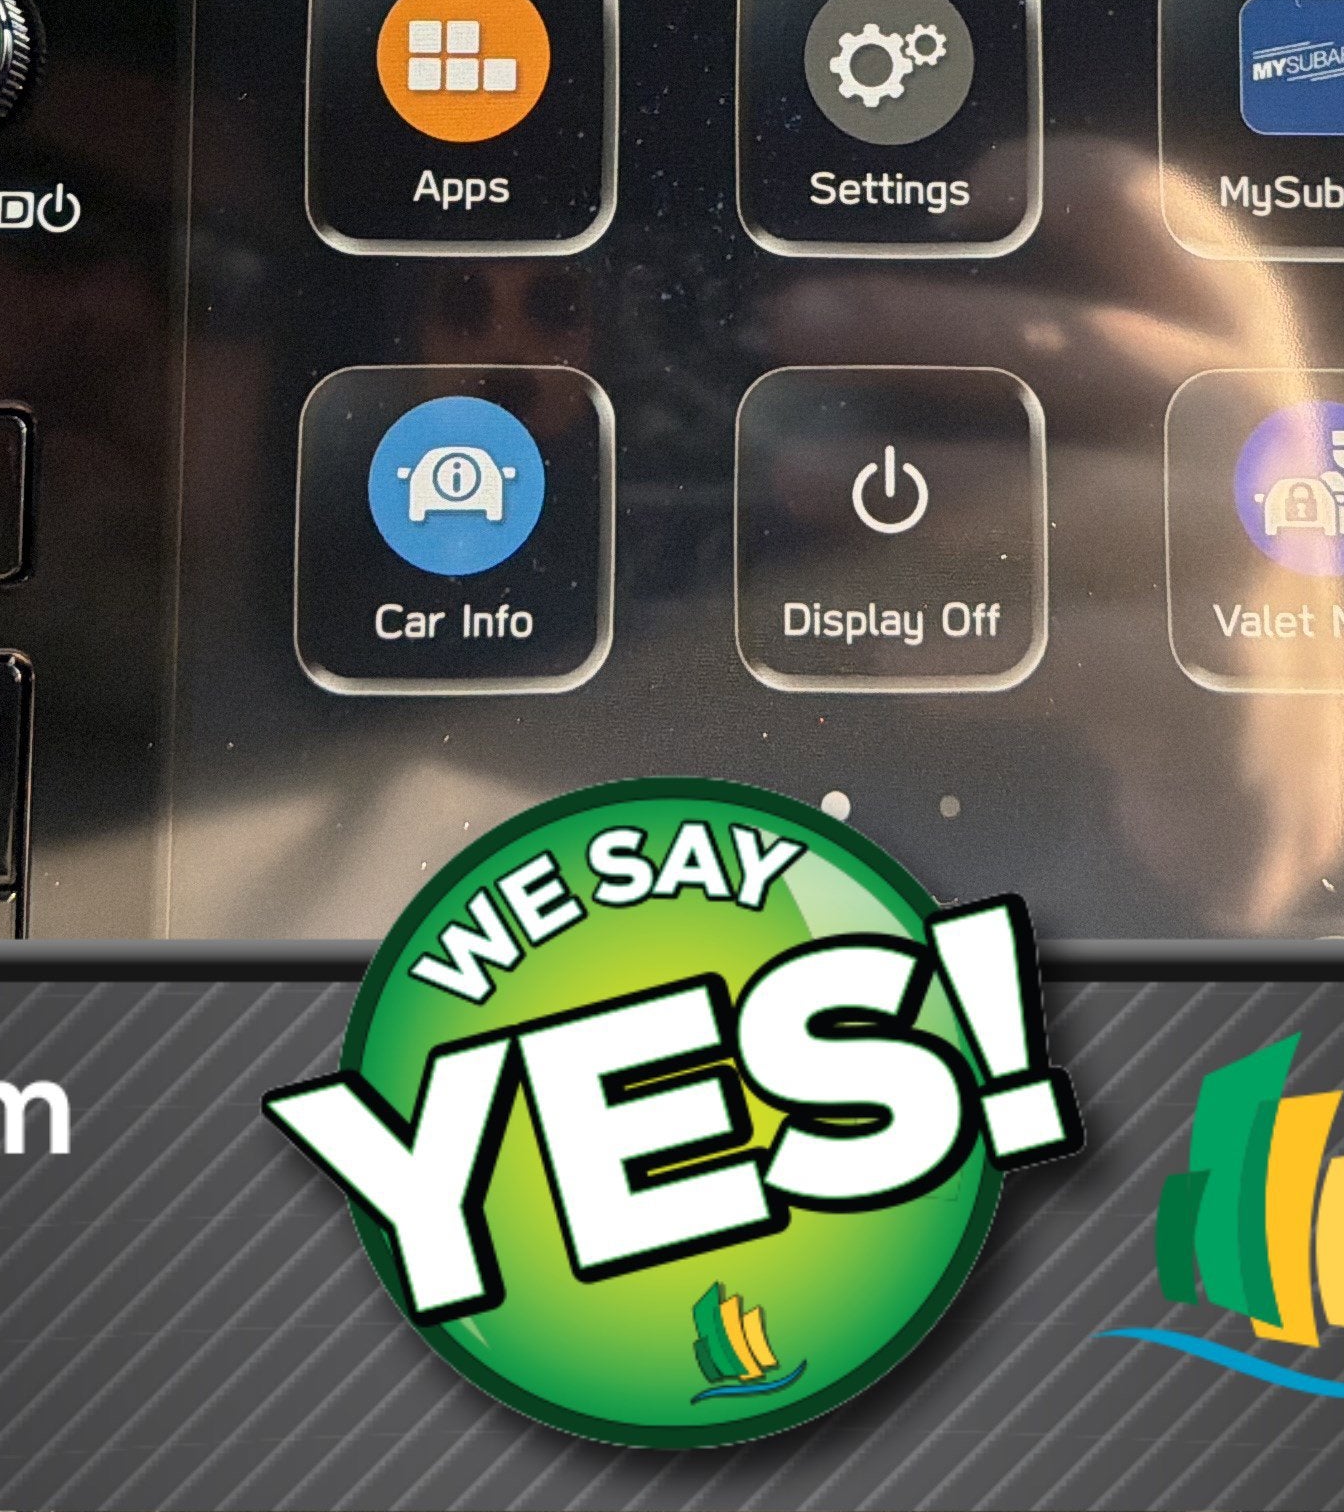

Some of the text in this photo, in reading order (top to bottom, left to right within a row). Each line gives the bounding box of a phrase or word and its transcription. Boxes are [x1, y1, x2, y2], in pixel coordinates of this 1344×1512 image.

[412, 169, 511, 211] Apps
[809, 171, 971, 214] Settings
[373, 602, 534, 641] Car Info
[782, 600, 1002, 645] Display Off
[1212, 603, 1316, 639] Valet
